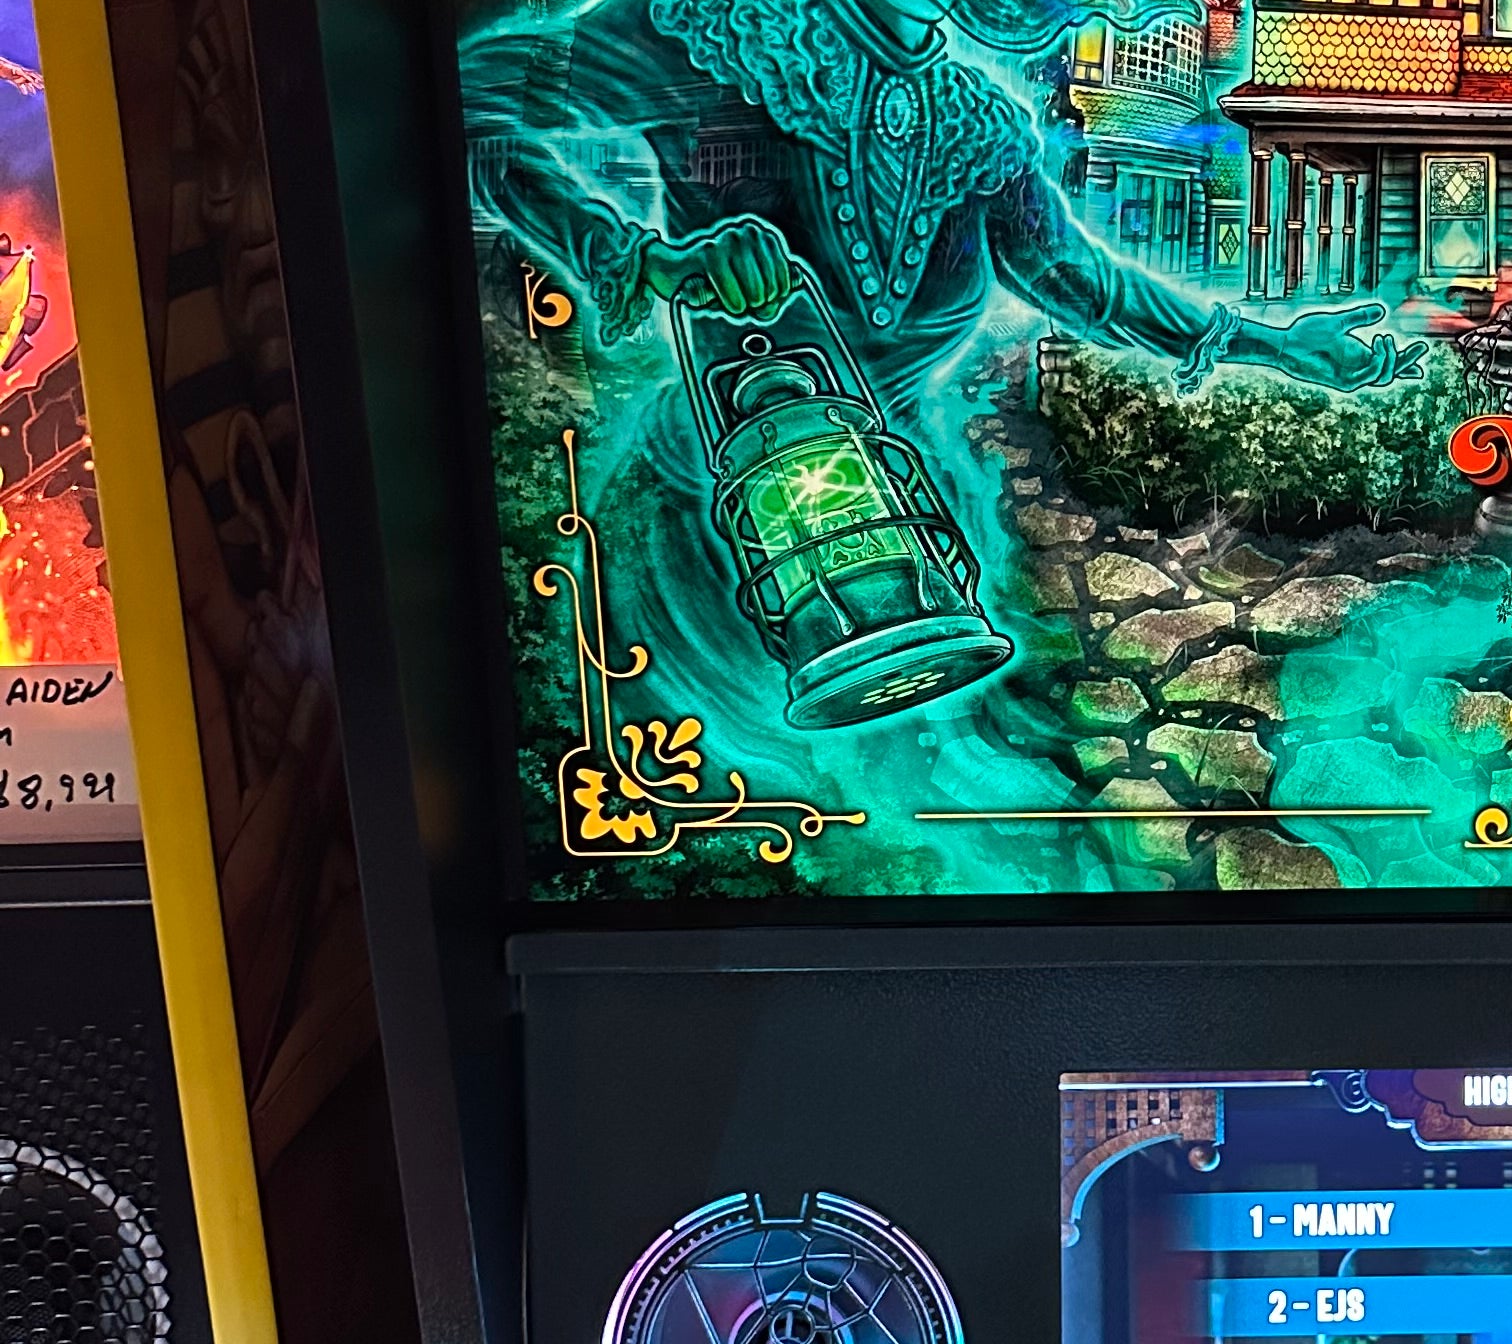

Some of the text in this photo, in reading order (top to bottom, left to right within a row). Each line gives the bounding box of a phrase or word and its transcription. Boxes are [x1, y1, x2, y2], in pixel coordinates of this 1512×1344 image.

[6, 671, 114, 706] AIDEN
[1250, 1204, 1263, 1238] 1
[1293, 1202, 1395, 1236] MANNY
[1268, 1290, 1287, 1323] 2
[1317, 1289, 1365, 1322] EJS
